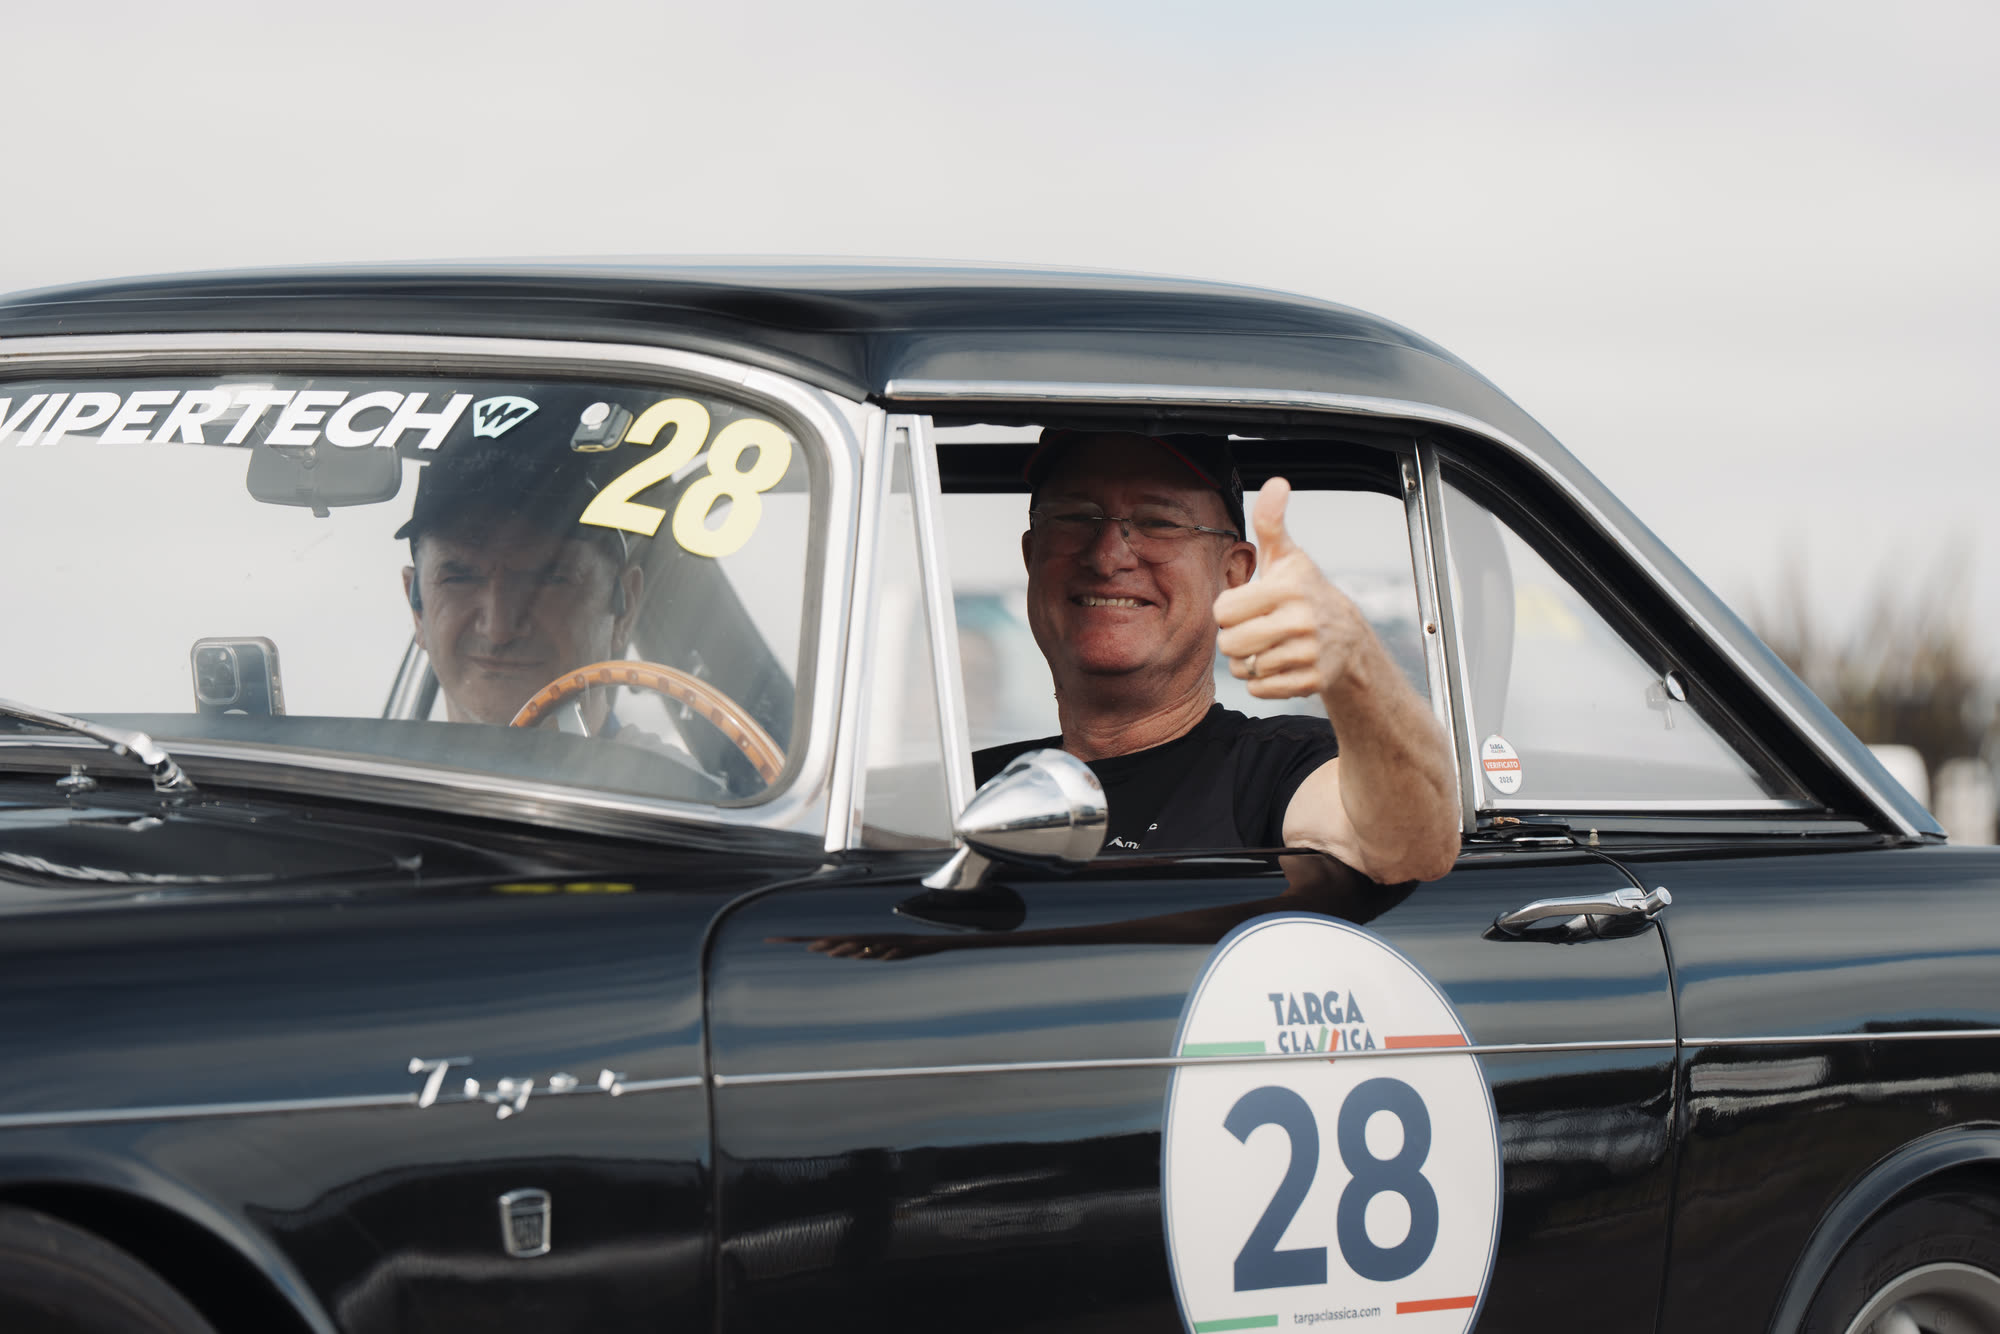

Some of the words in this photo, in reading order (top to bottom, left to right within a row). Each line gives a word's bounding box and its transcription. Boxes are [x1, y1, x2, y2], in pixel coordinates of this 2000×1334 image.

[0, 390, 474, 450] VIPERTECH
[580, 398, 793, 558] 28
[1485, 761, 1518, 769] VERIFICATO
[1268, 990, 1365, 1026] TARGA
[1223, 1077, 1439, 1292] 28
[1293, 1306, 1381, 1325] targaclassica.com
